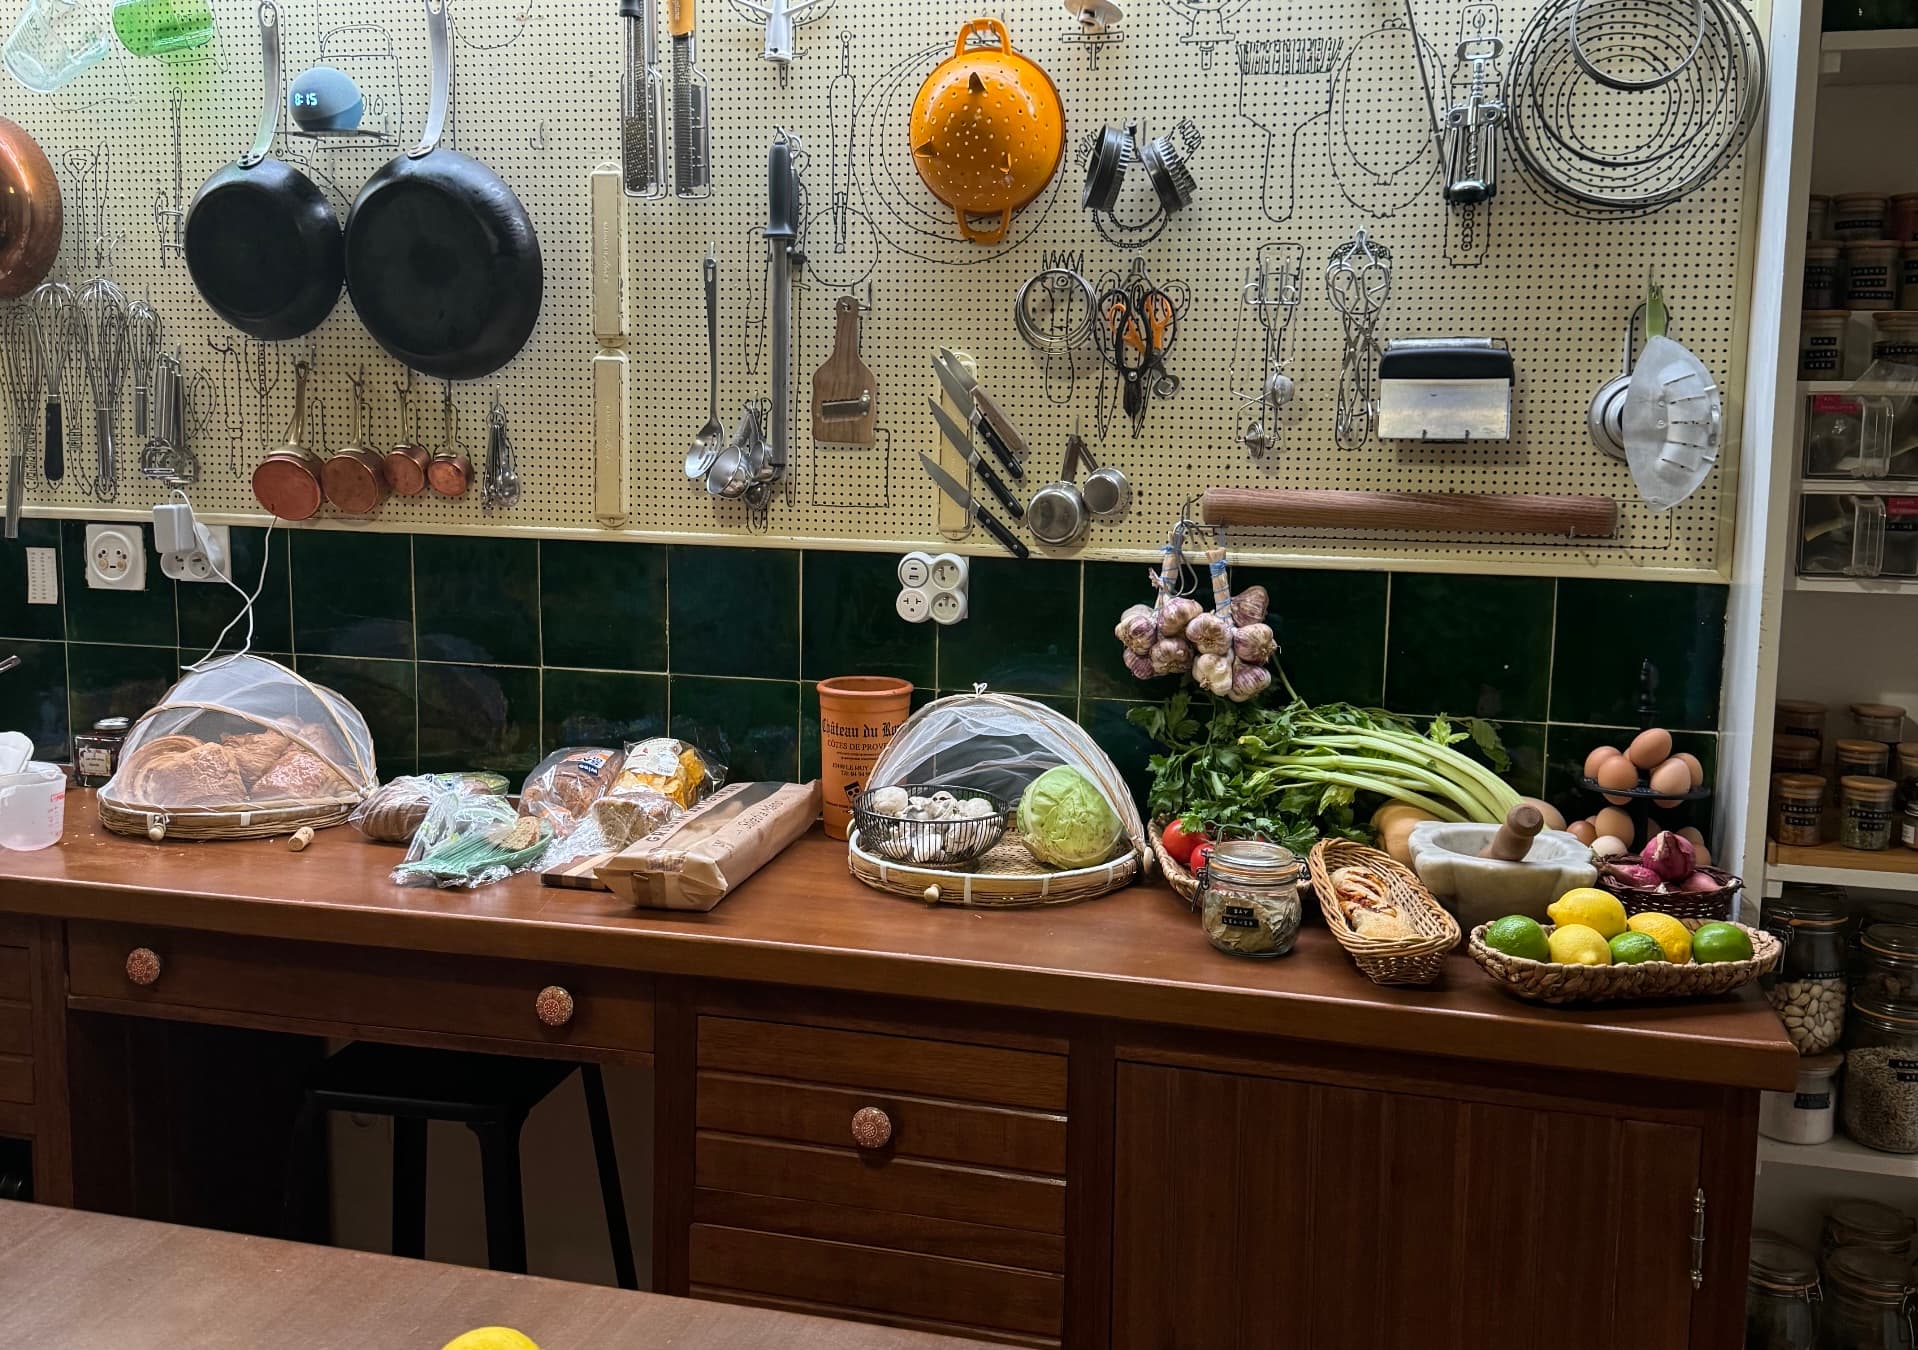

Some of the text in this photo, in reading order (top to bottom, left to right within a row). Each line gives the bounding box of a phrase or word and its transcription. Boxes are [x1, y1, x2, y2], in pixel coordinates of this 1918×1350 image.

[294, 92, 318, 106] 8:15
[863, 723, 878, 738] du
[1223, 917, 1253, 926] LEAVES
